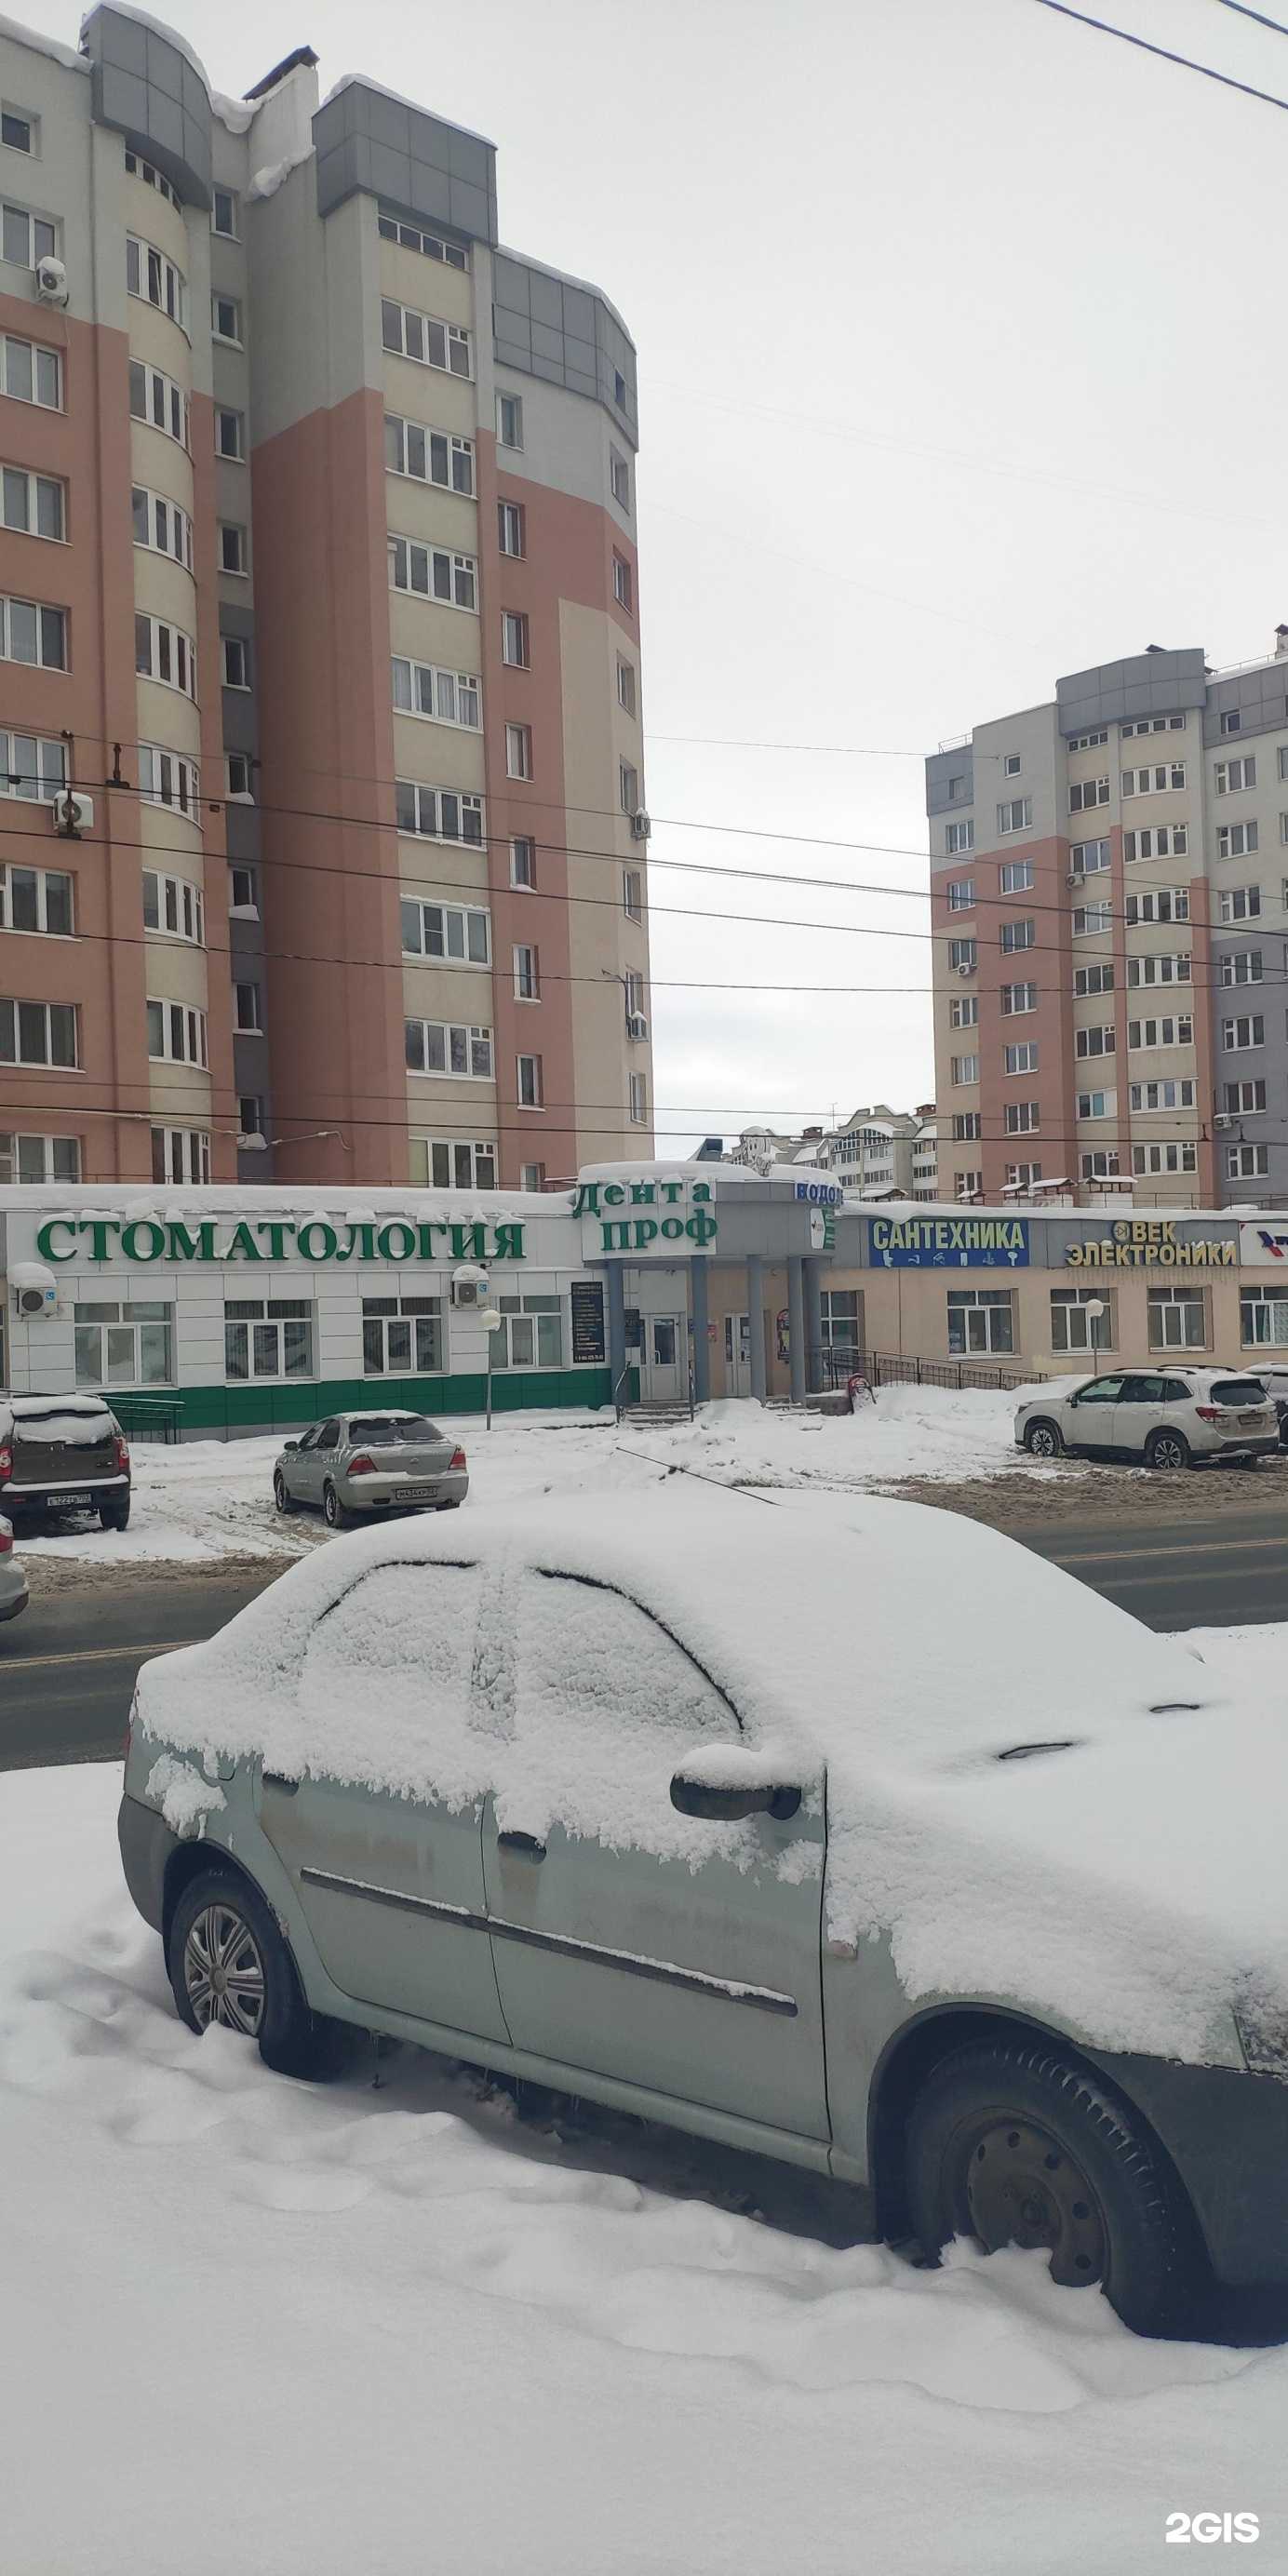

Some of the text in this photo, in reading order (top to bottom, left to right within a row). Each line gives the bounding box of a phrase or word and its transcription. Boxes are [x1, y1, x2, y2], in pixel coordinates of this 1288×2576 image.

[573, 1183, 713, 1218] Дента
[36, 1219, 528, 1262] СТОМАТОЛОГИЯ
[873, 1220, 1025, 1250] САНТЕХНИКА
[1132, 1220, 1176, 1242] ВЕК
[1065, 1243, 1237, 1267] ЭЛЕКТРОНИКИ
